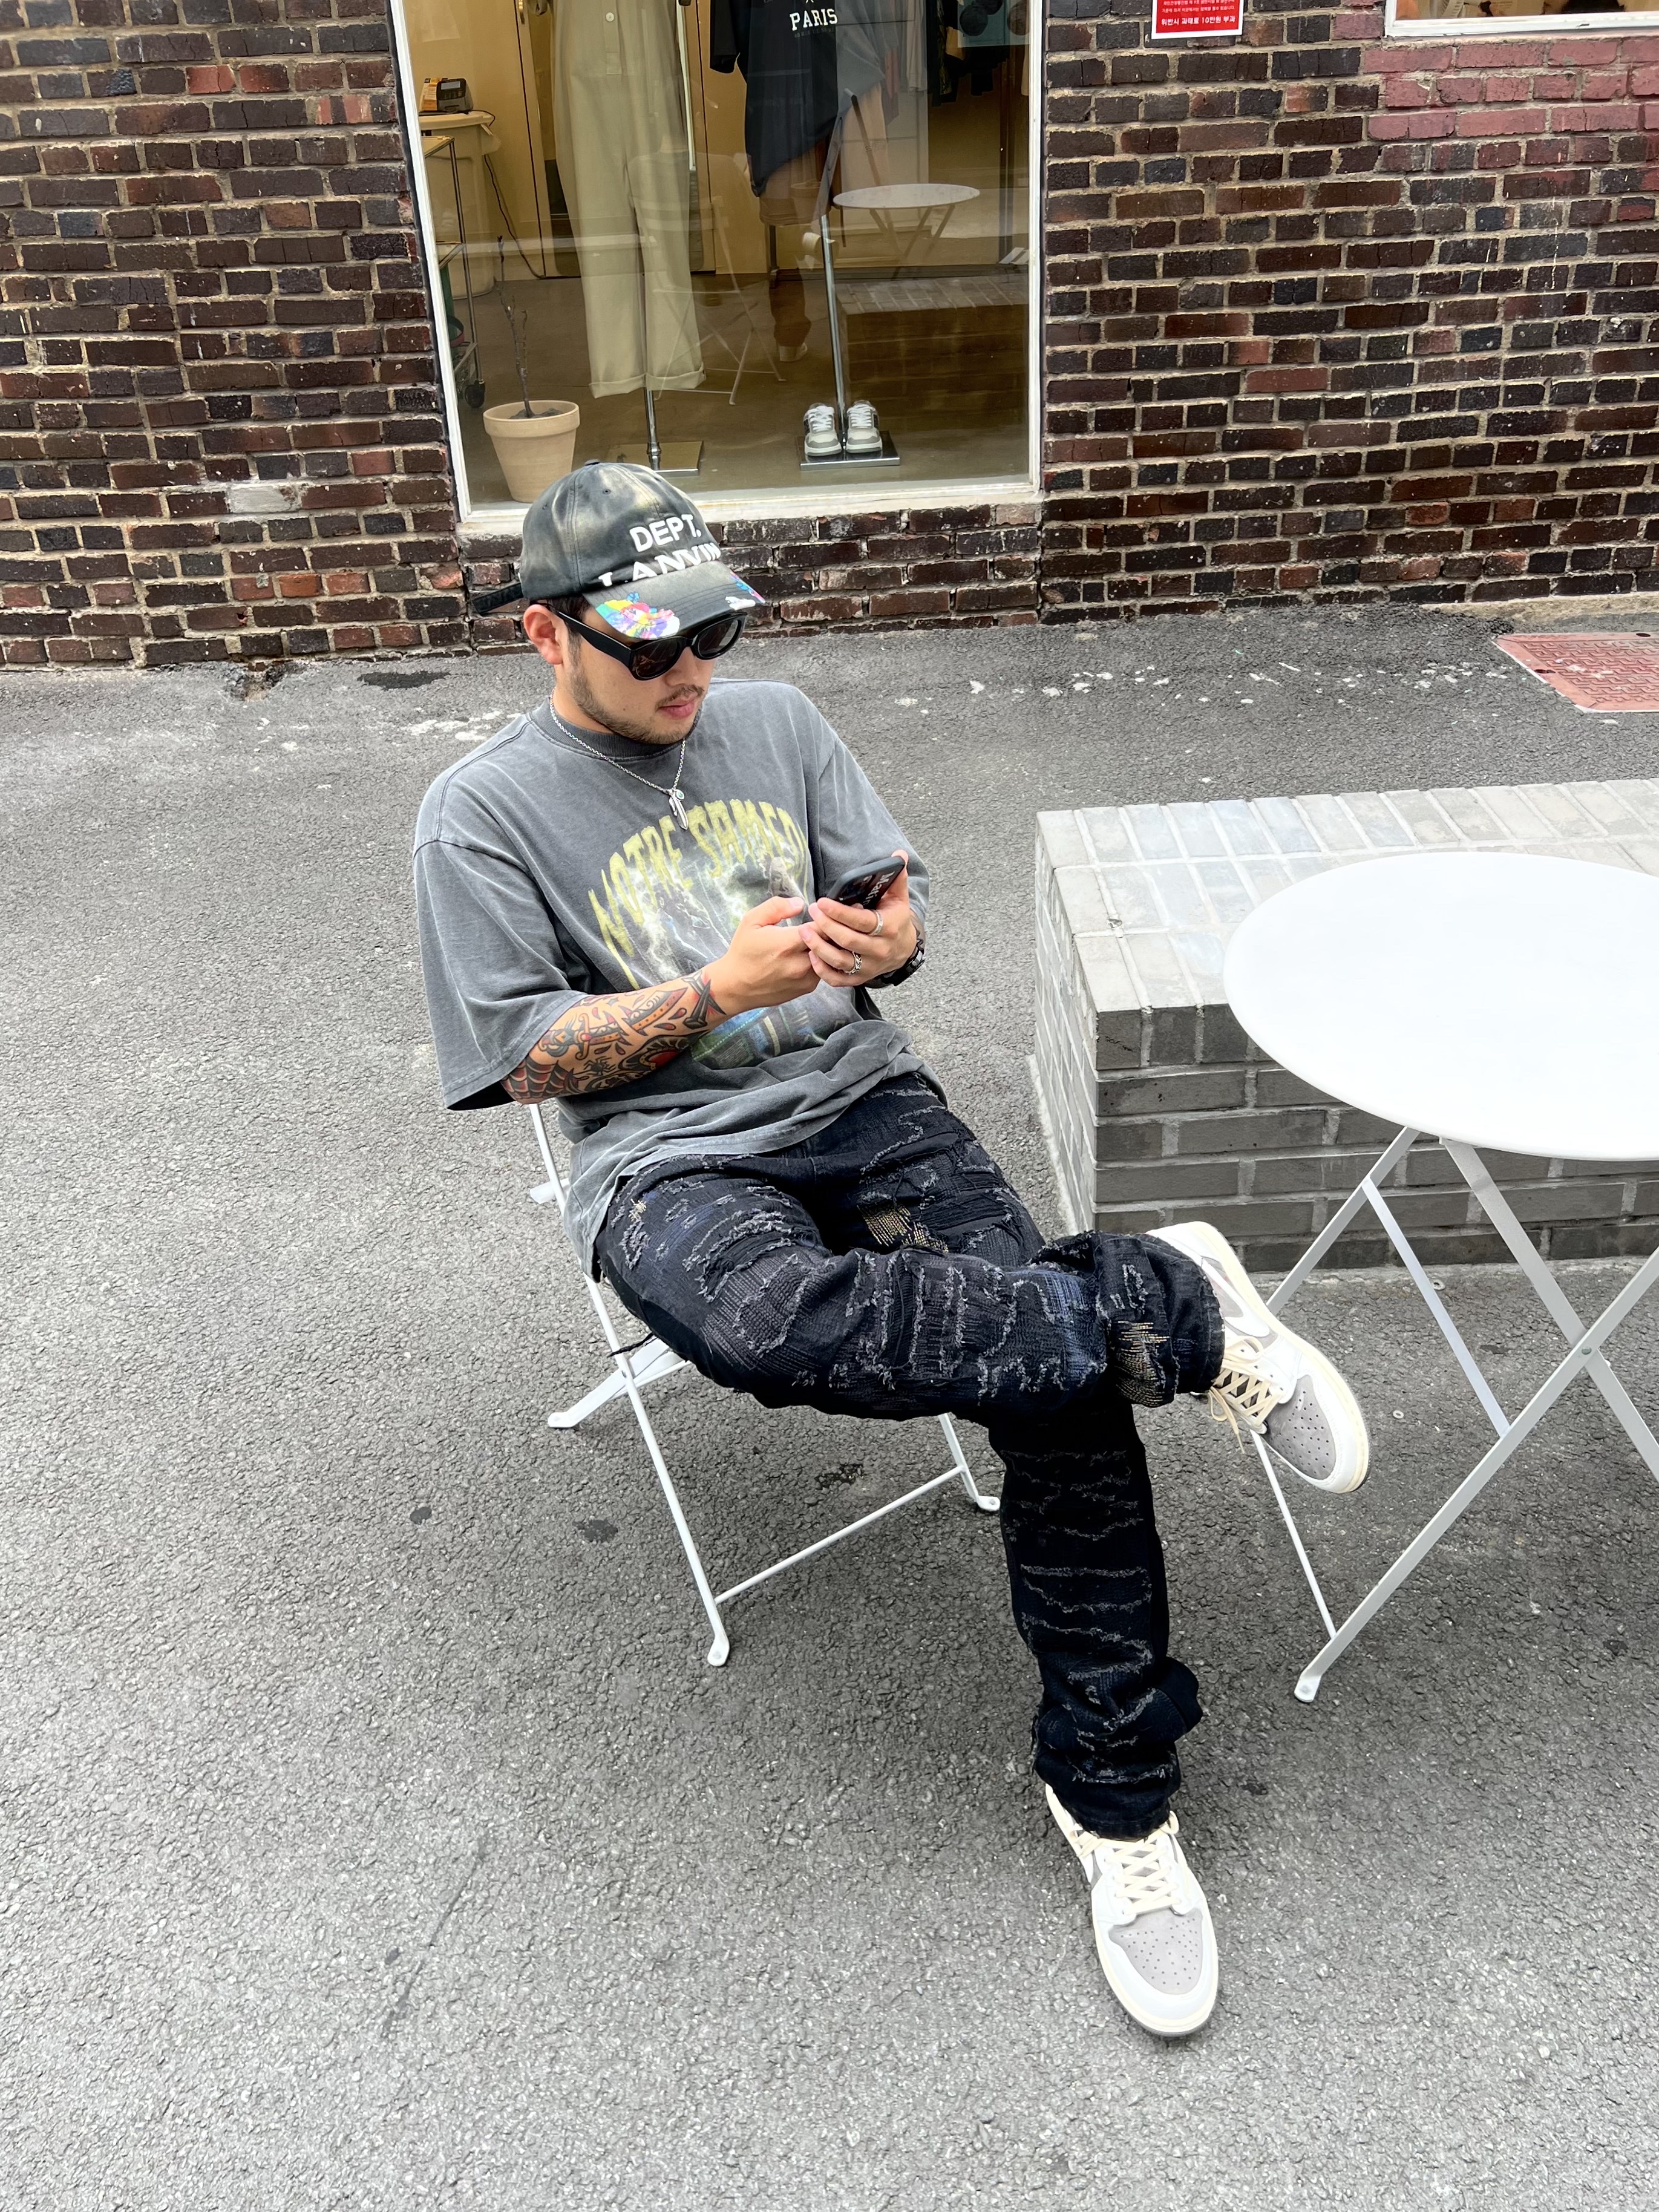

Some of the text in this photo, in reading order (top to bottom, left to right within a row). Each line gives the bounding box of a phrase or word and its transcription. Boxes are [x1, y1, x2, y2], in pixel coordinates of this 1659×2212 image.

[790, 8, 838, 31] PARIS
[629, 514, 702, 552] DEPT.
[588, 814, 694, 990] NOTRE
[863, 871, 895, 906] Matin
